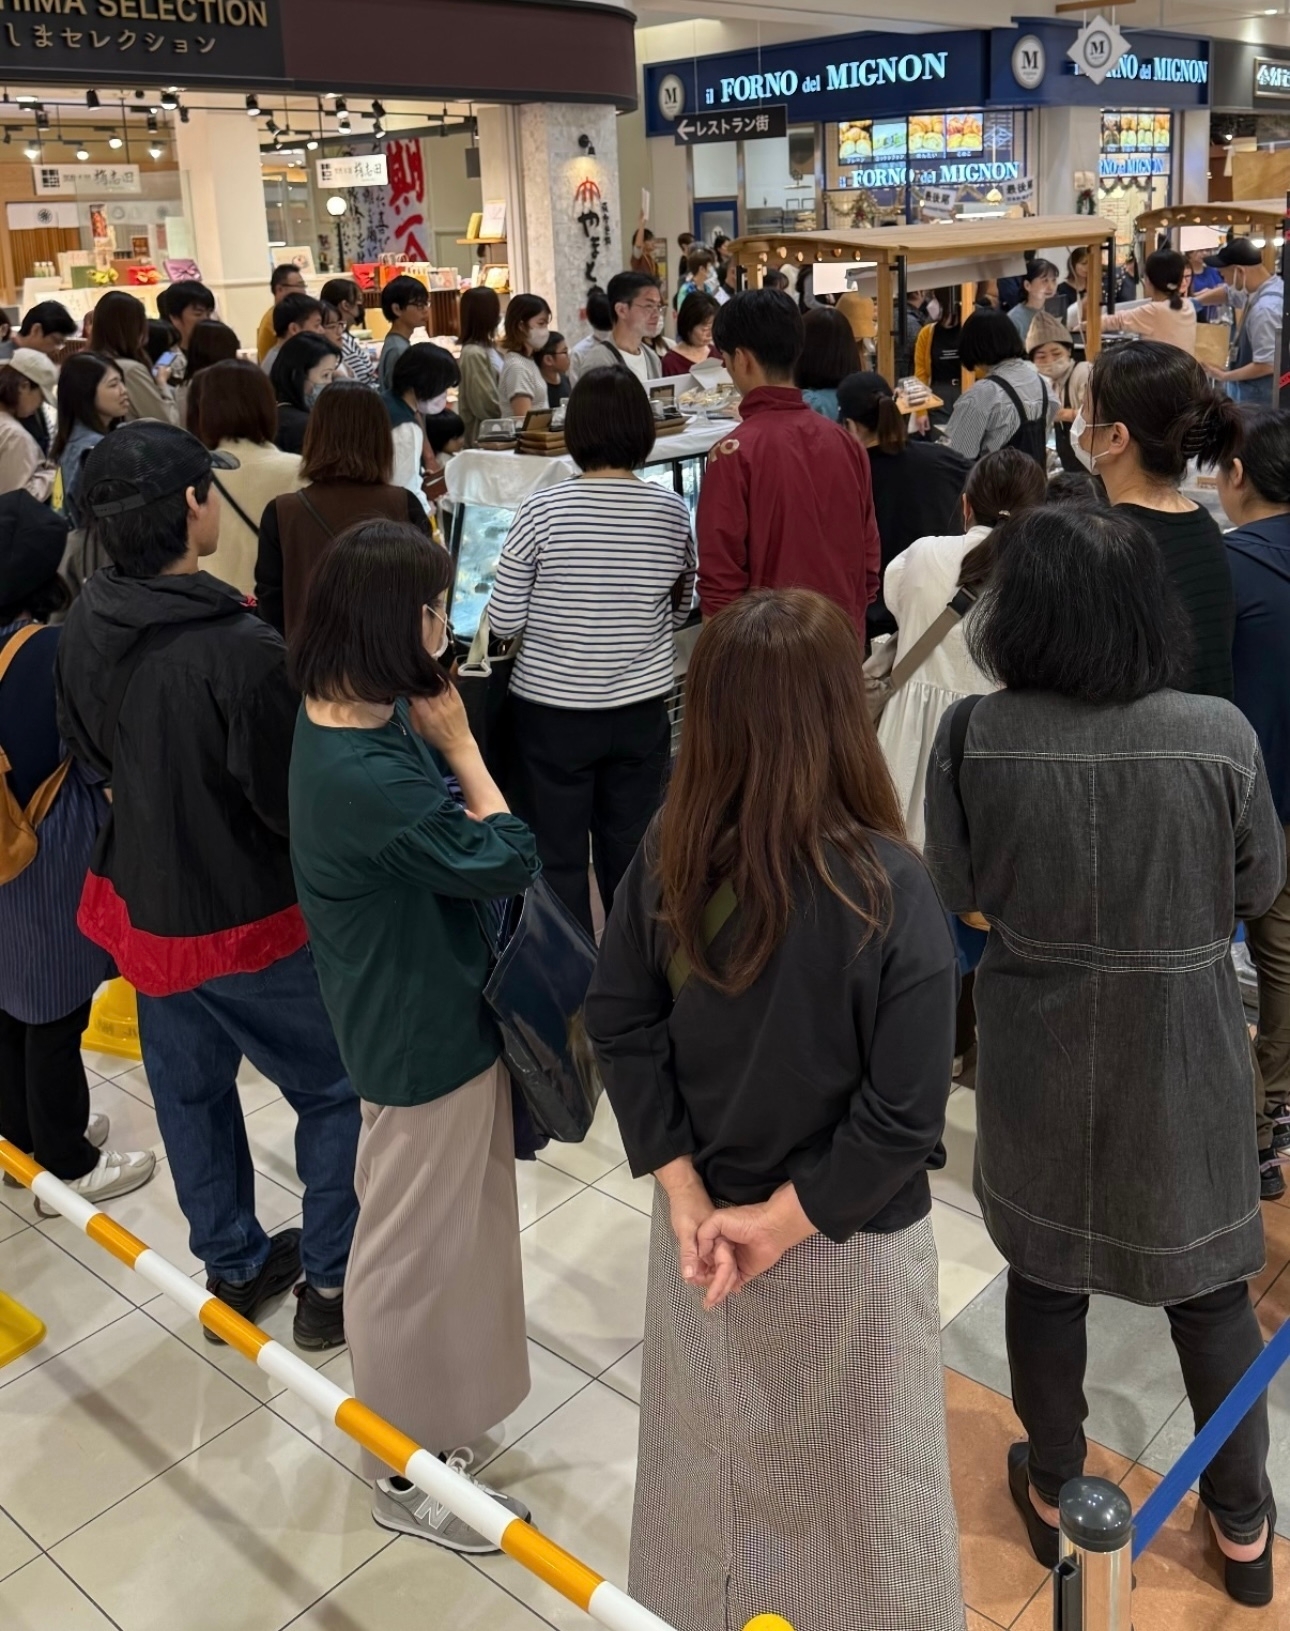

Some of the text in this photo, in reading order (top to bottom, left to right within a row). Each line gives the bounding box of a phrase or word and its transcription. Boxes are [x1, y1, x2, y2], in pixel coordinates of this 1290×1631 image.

[99, 0, 268, 27] SELECTION
[6, 23, 216, 53] しまセレクション
[1090, 40, 1106, 56] M
[1021, 50, 1039, 69] M
[1139, 63, 1151, 80] del
[1153, 57, 1208, 84] MIGNON
[705, 52, 948, 104] il FORNO del MIGNON
[664, 87, 677, 104] M
[696, 115, 769, 136] レストラン街
[852, 167, 915, 187] FORNO
[939, 161, 1019, 183] MIGNON
[577, 209, 601, 283] やまと
